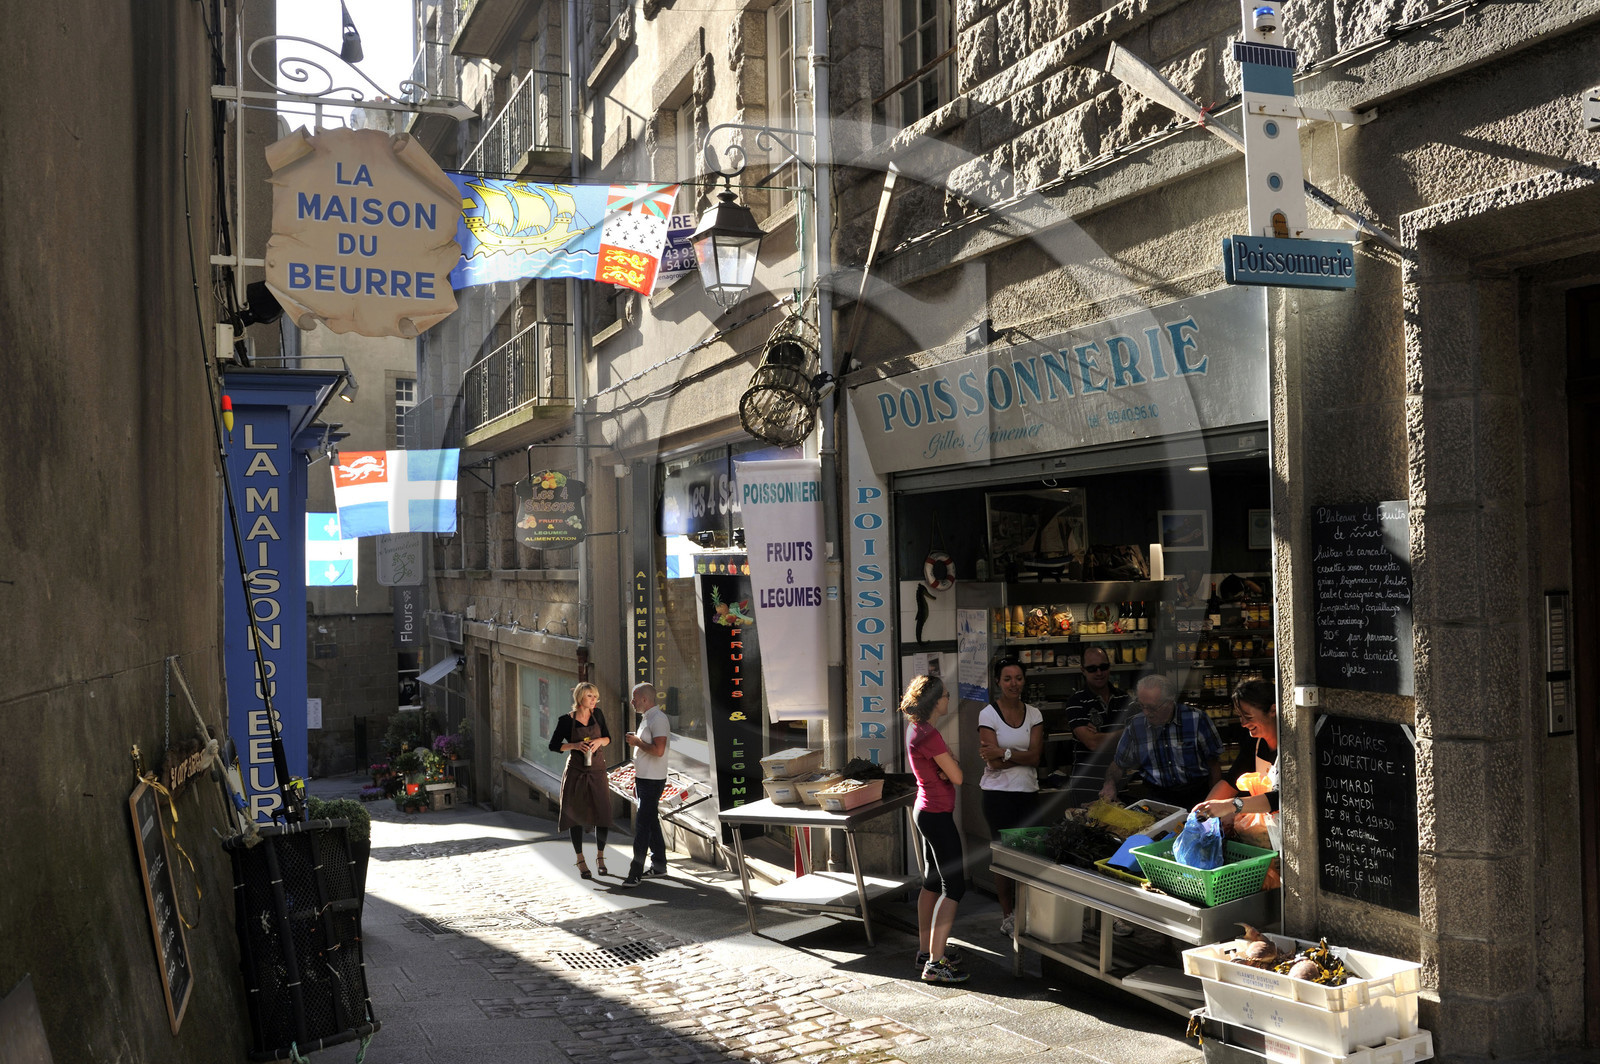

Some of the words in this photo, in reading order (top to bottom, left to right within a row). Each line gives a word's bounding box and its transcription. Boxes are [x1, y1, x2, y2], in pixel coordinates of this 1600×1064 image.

[336, 161, 374, 188] LA
[296, 191, 438, 231] MAISON
[338, 232, 378, 257] DU
[1236, 241, 1353, 279] Poissonnerie
[288, 262, 437, 300] BEURRE
[877, 313, 1210, 434] POISSONNERIE
[922, 429, 966, 460] Gilles
[967, 421, 1045, 455] Guinemer
[244, 424, 281, 477] LA
[532, 486, 555, 500] Les
[560, 486, 569, 500] 4
[524, 499, 576, 514] Saisons
[1316, 507, 1356, 524] Plateaux
[1362, 506, 1375, 522] de
[1376, 505, 1406, 524] Fruits
[1334, 525, 1346, 540] de
[766, 541, 813, 563] FRUITS
[1345, 544, 1355, 557] de
[786, 568, 795, 584] &
[1382, 574, 1408, 586] bulots
[760, 586, 822, 609] LEGUMES
[399, 603, 414, 642] Fleurs
[1346, 632, 1363, 646] par
[730, 628, 745, 698] FRUITS
[1363, 649, 1399, 662] domicile
[729, 711, 747, 721] &
[1325, 776, 1339, 790] DU
[1325, 792, 1339, 805] AU
[1324, 808, 1336, 820] DE
[1339, 809, 1350, 823] 8H
[1354, 812, 1363, 825] à
[1330, 825, 1344, 837] en
[1353, 854, 1361, 867] à
[1363, 857, 1379, 870] 13H
[1354, 870, 1364, 882] LE
